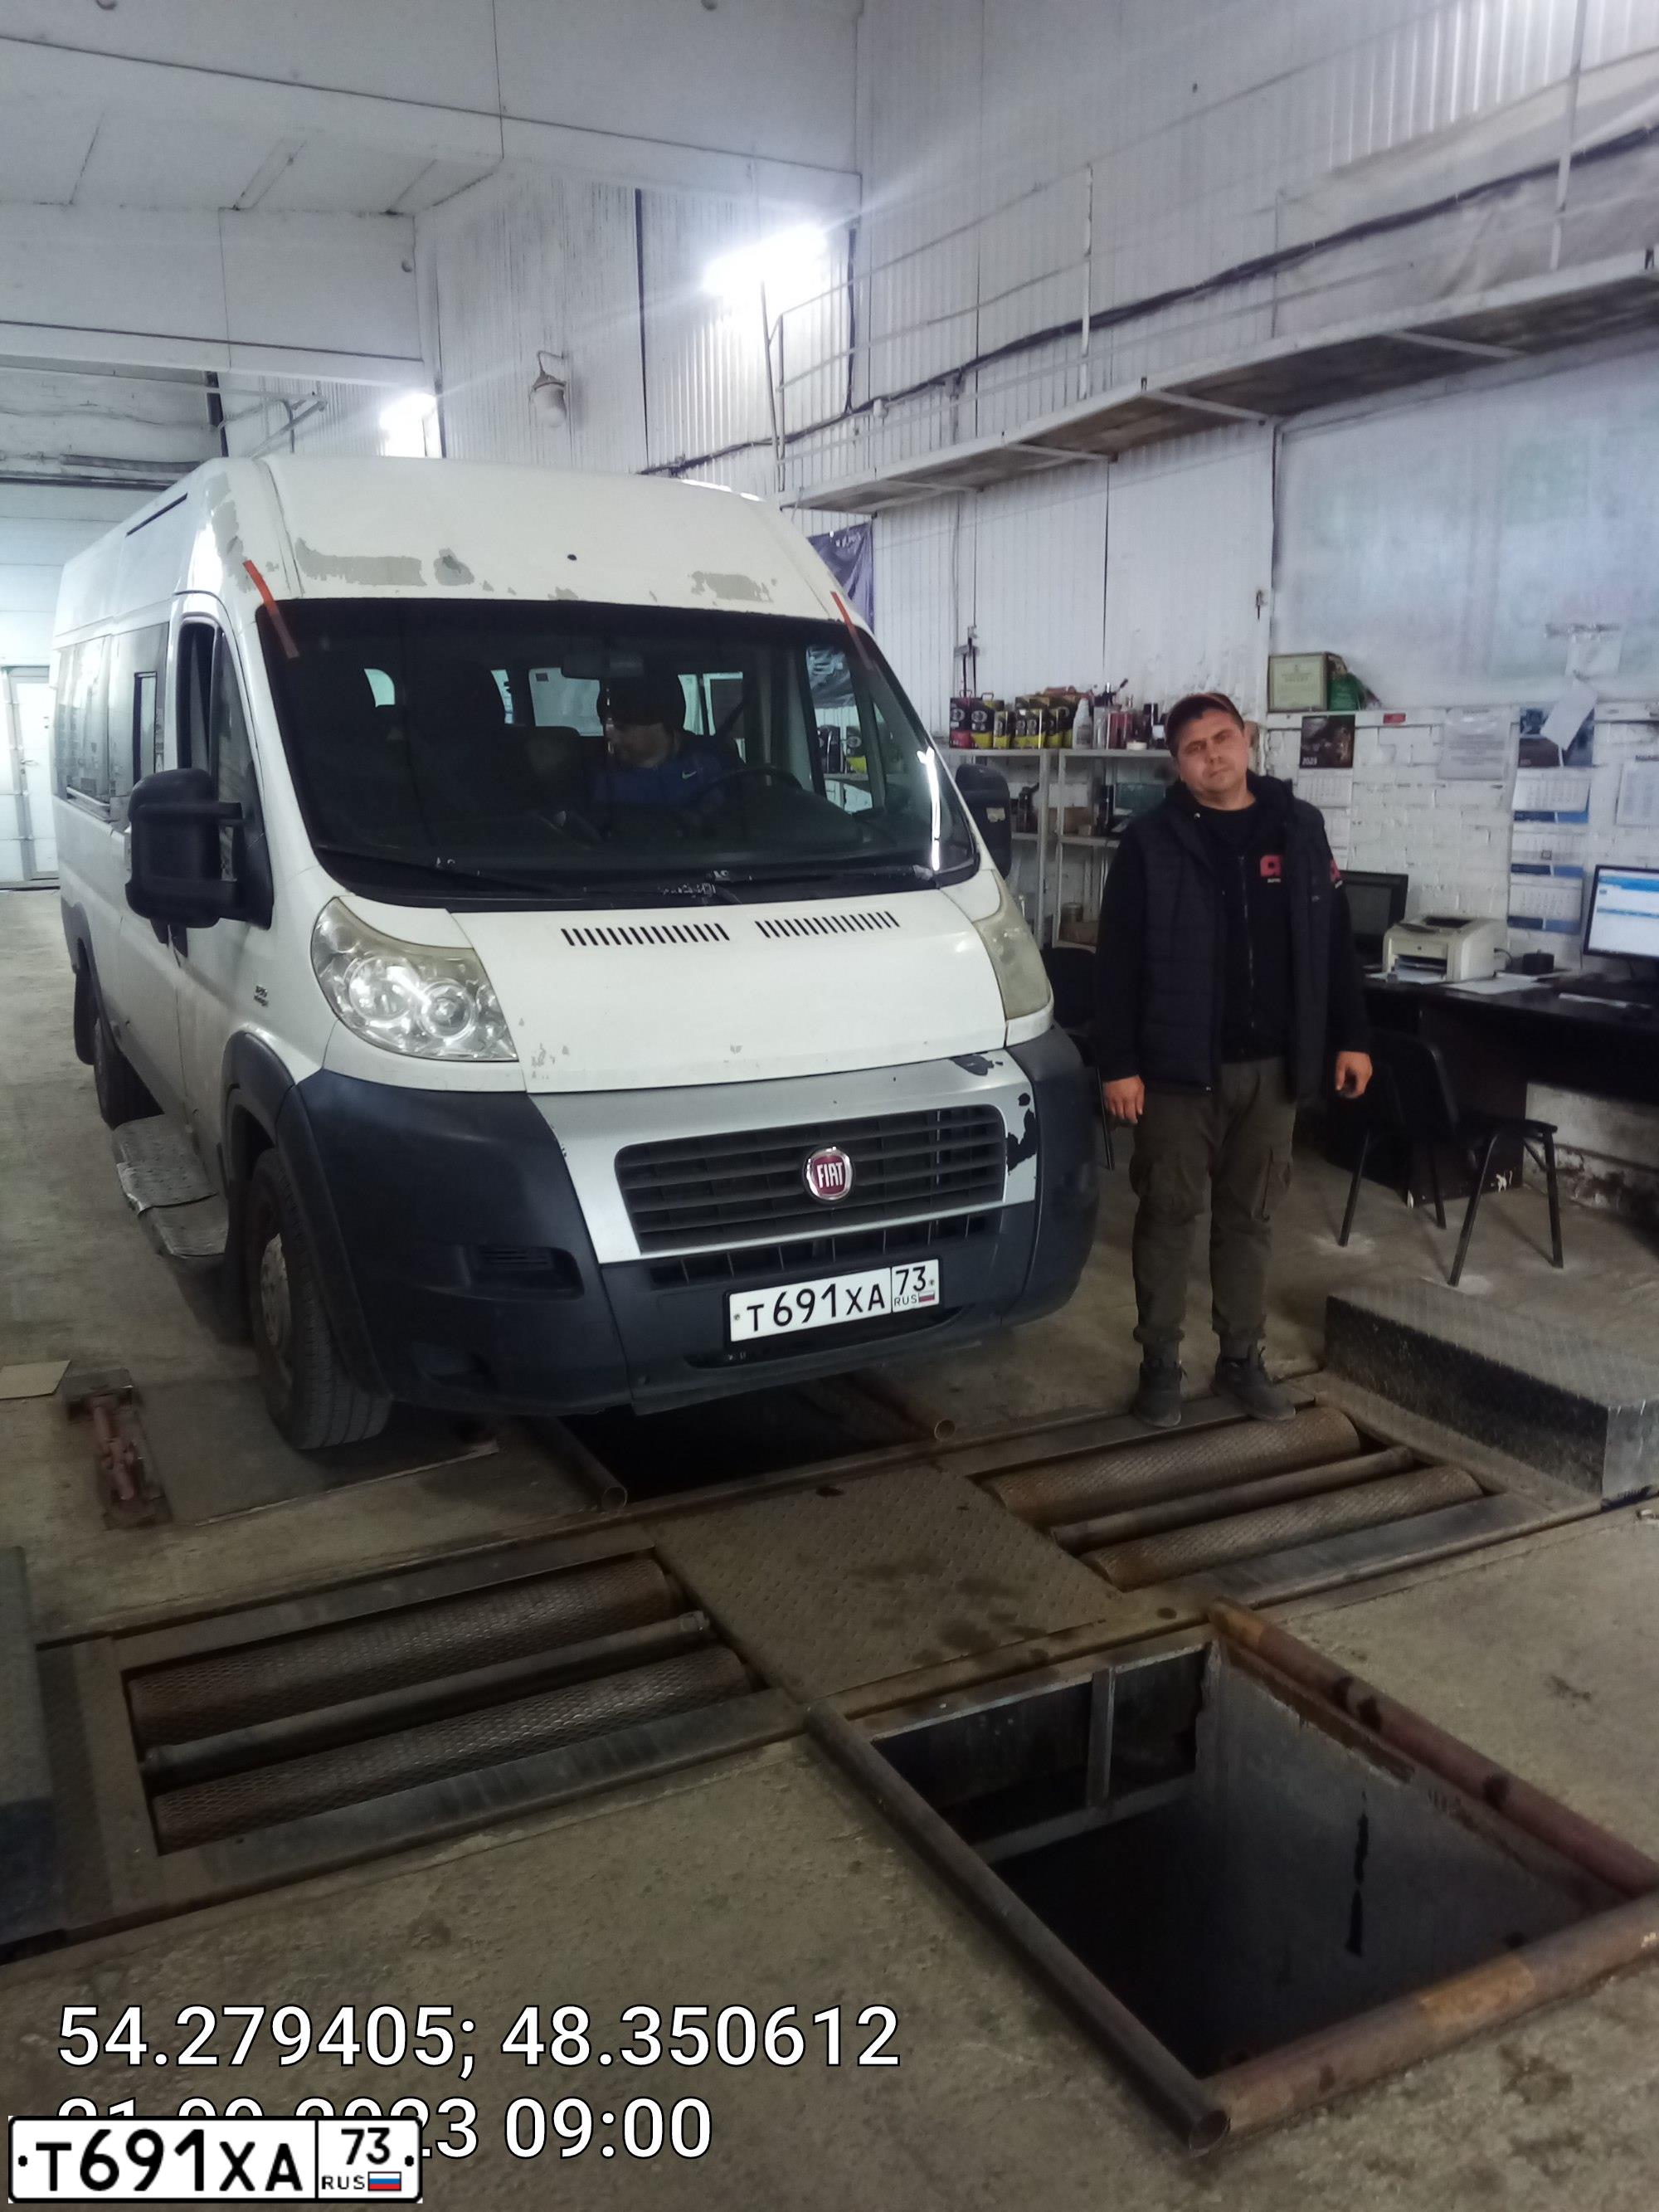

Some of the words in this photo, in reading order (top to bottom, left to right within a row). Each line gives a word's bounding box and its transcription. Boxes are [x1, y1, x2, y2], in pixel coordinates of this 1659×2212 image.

[816, 1162, 843, 1188] FIAT
[896, 1265, 927, 1296] 73
[893, 1294, 917, 1307] RUS
